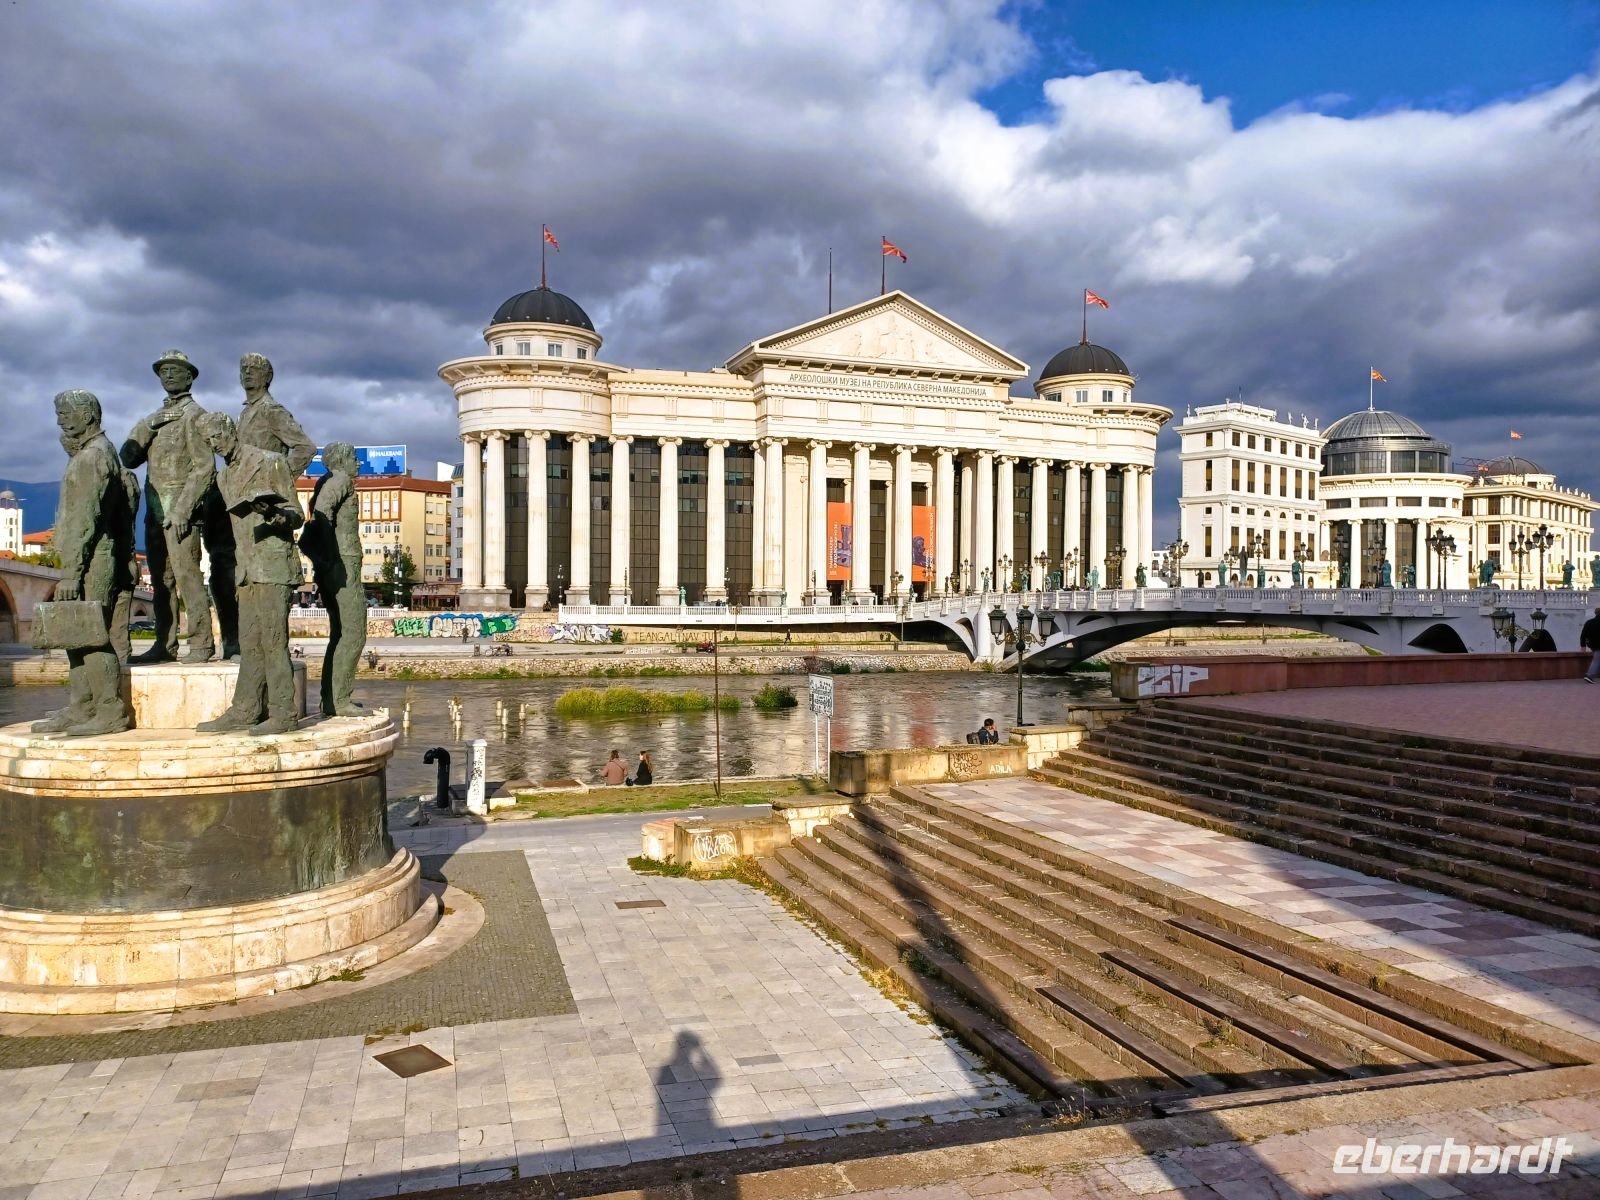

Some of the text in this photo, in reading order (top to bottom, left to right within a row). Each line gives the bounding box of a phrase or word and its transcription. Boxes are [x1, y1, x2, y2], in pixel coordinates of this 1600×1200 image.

[789, 373, 987, 397] АРХЕОЛОШКИ МУЗЕЈ НА РЕПУБЛИКА СЕВЕРНА МАКЕДОНИЈА
